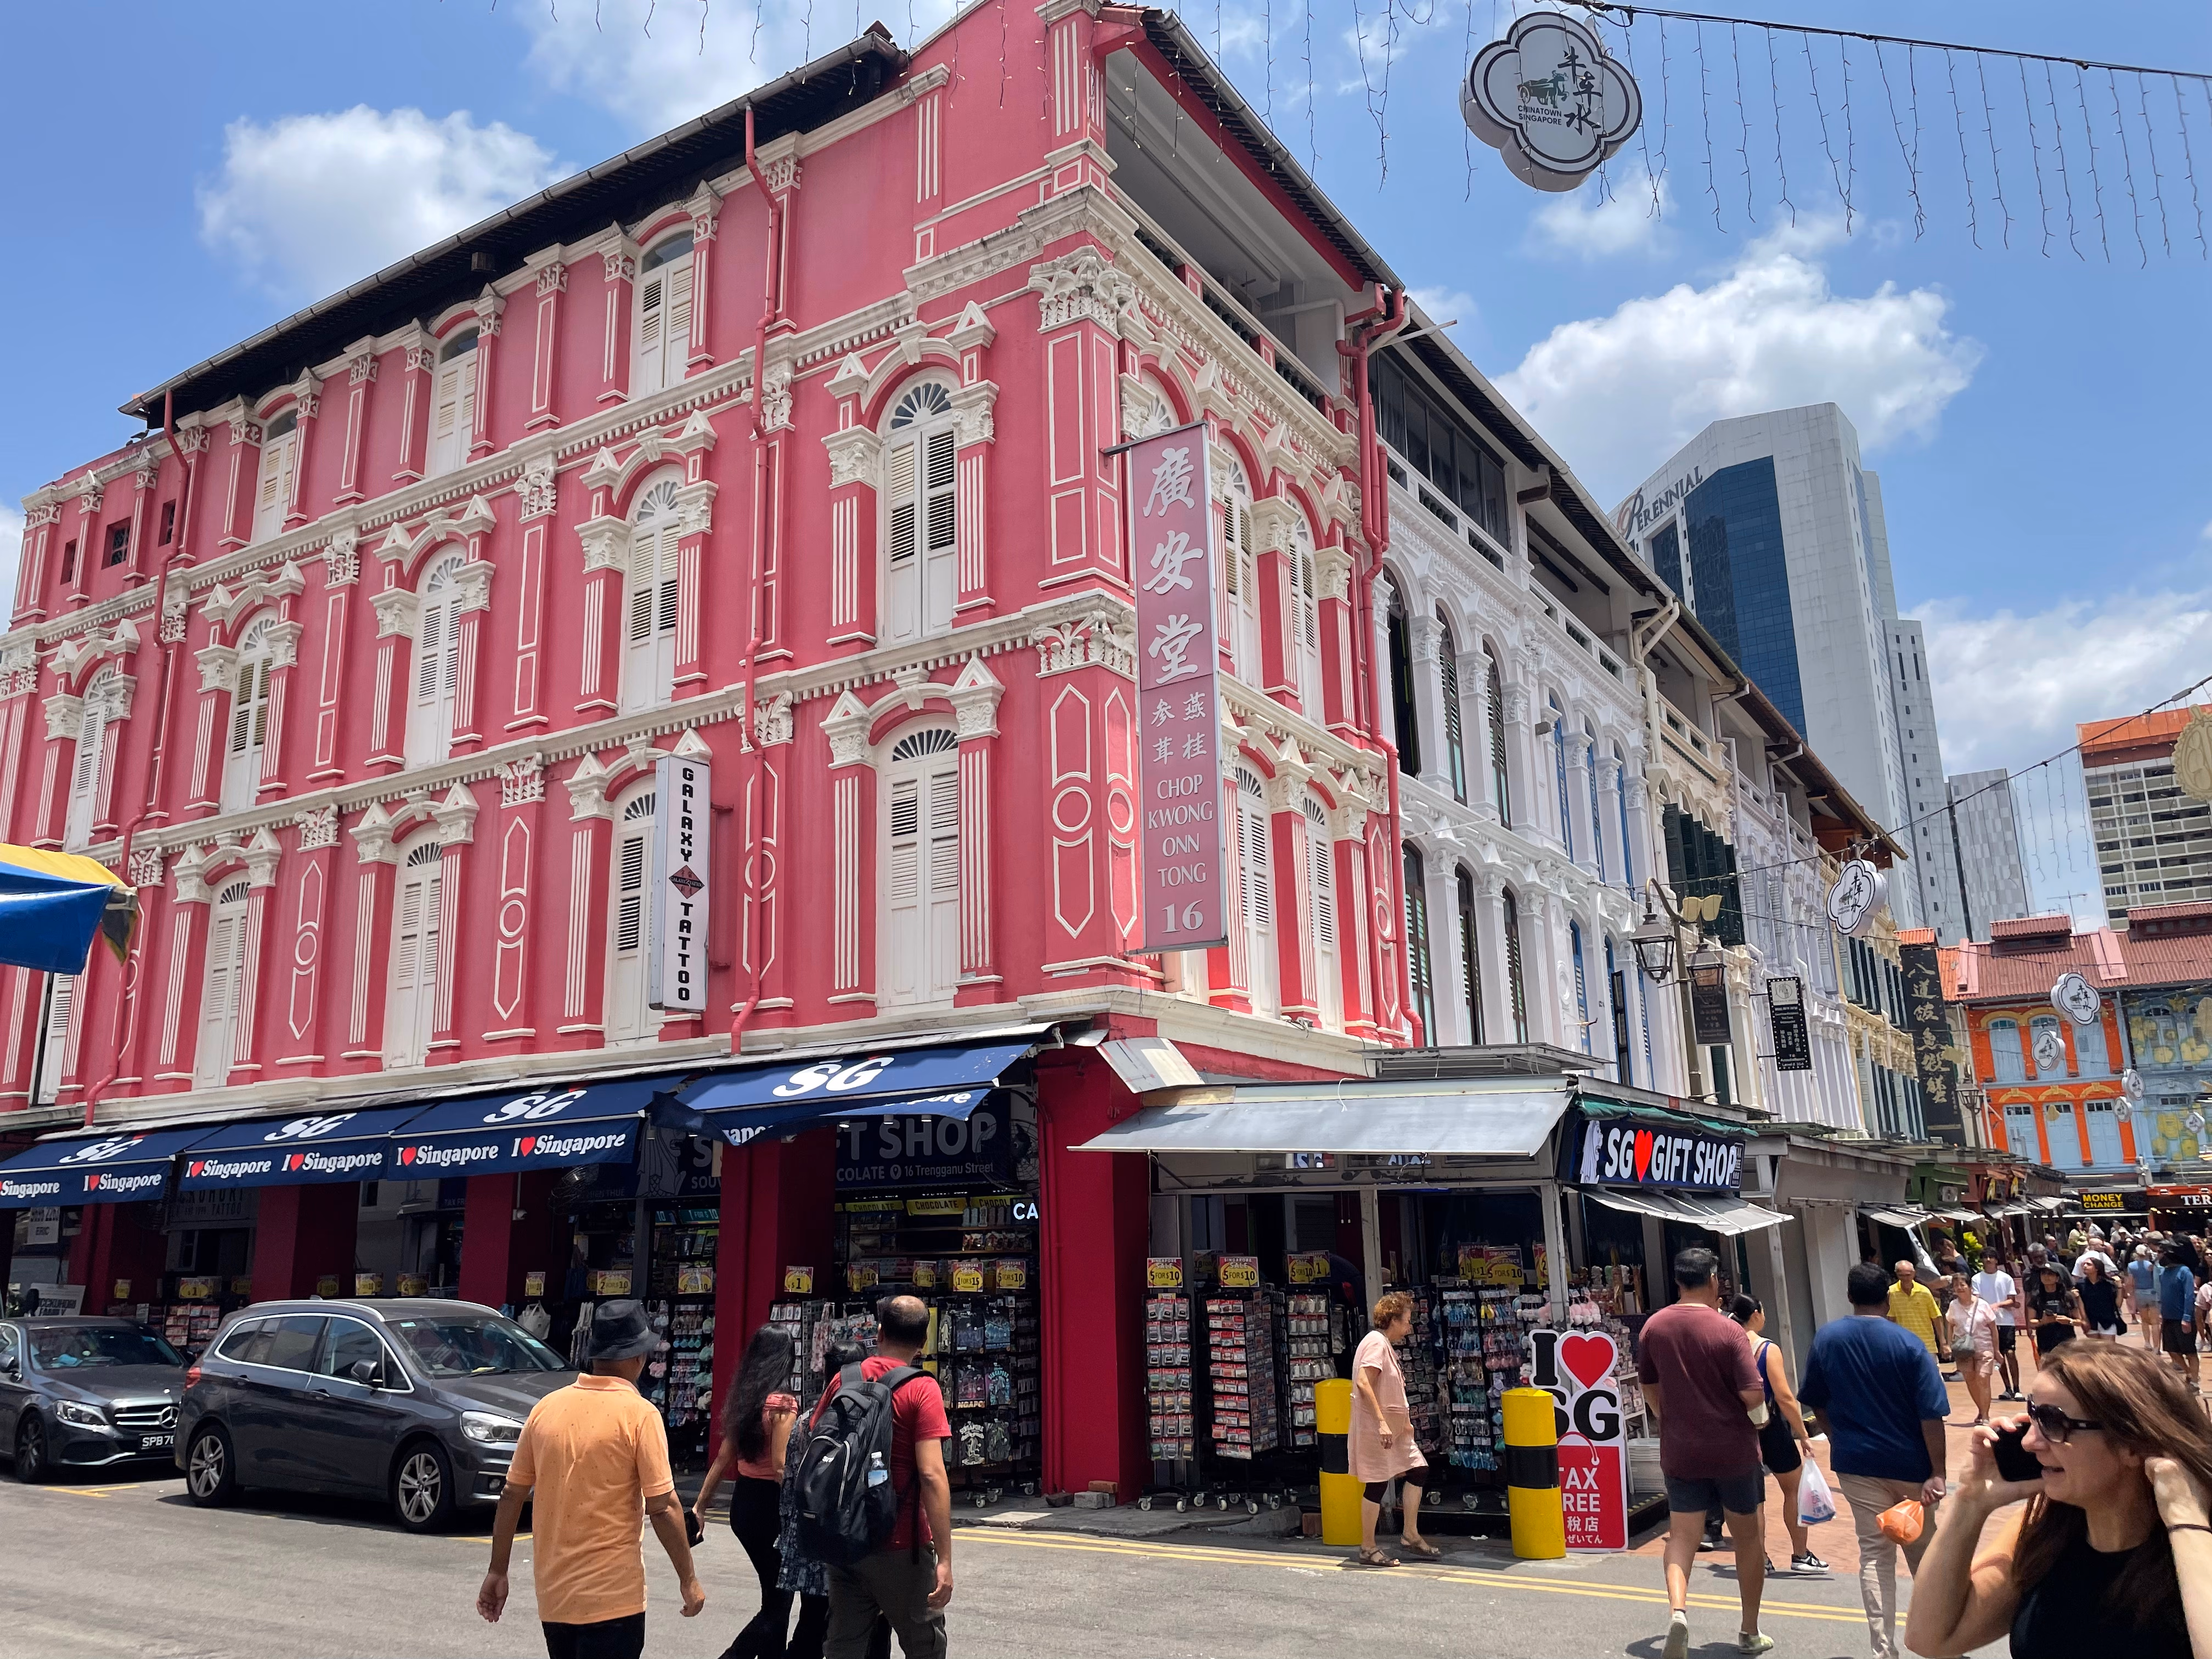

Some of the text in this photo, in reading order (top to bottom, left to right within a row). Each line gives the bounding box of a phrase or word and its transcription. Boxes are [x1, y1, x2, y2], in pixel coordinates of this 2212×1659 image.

[1517, 105, 1562, 117] CHINATOWN
[1519, 114, 1562, 126] SINGAPORE
[1142, 447, 1204, 685] 廣安堂
[1156, 774, 1204, 800] CHOP
[680, 767, 695, 862] GALAXY
[1148, 800, 1214, 830] KWONG
[1162, 833, 1200, 857] ONN
[1158, 862, 1207, 888] TONG
[1161, 899, 1204, 934] 16
[678, 902, 693, 1001] TATTOO
[772, 1057, 895, 1097] SG
[483, 1090, 588, 1123] SG
[263, 1113, 358, 1141] SG
[879, 1112, 997, 1159] SHOP
[59, 1139, 144, 1164] SG
[396, 1144, 499, 1167] I Singapore
[511, 1132, 627, 1157] I Singapore
[281, 1152, 383, 1173] I Singapore
[1605, 1128, 1635, 1180] SG
[1651, 1134, 1693, 1183] GIFT
[1694, 1141, 1736, 1186] SHOP
[185, 1159, 272, 1179] I Singapore
[836, 1166, 885, 1182] COLATE
[904, 1162, 994, 1179] 16 Trengganu Street
[1, 1180, 60, 1198] Singapore
[83, 1173, 162, 1192] I Singapore
[915, 1200, 958, 1210] CHOCOLATE
[979, 1199, 1009, 1208] CHOCOL
[2083, 1193, 2123, 1202] MONEY
[1013, 1202, 1039, 1221] CA
[1150, 1271, 1155, 1280] 5
[1223, 1271, 1229, 1280] 5
[1532, 1332, 1559, 1386] I
[1558, 1467, 1598, 1490] AX
[1562, 1493, 1601, 1513] REE
[1566, 1534, 1603, 1545] ぜいてん
